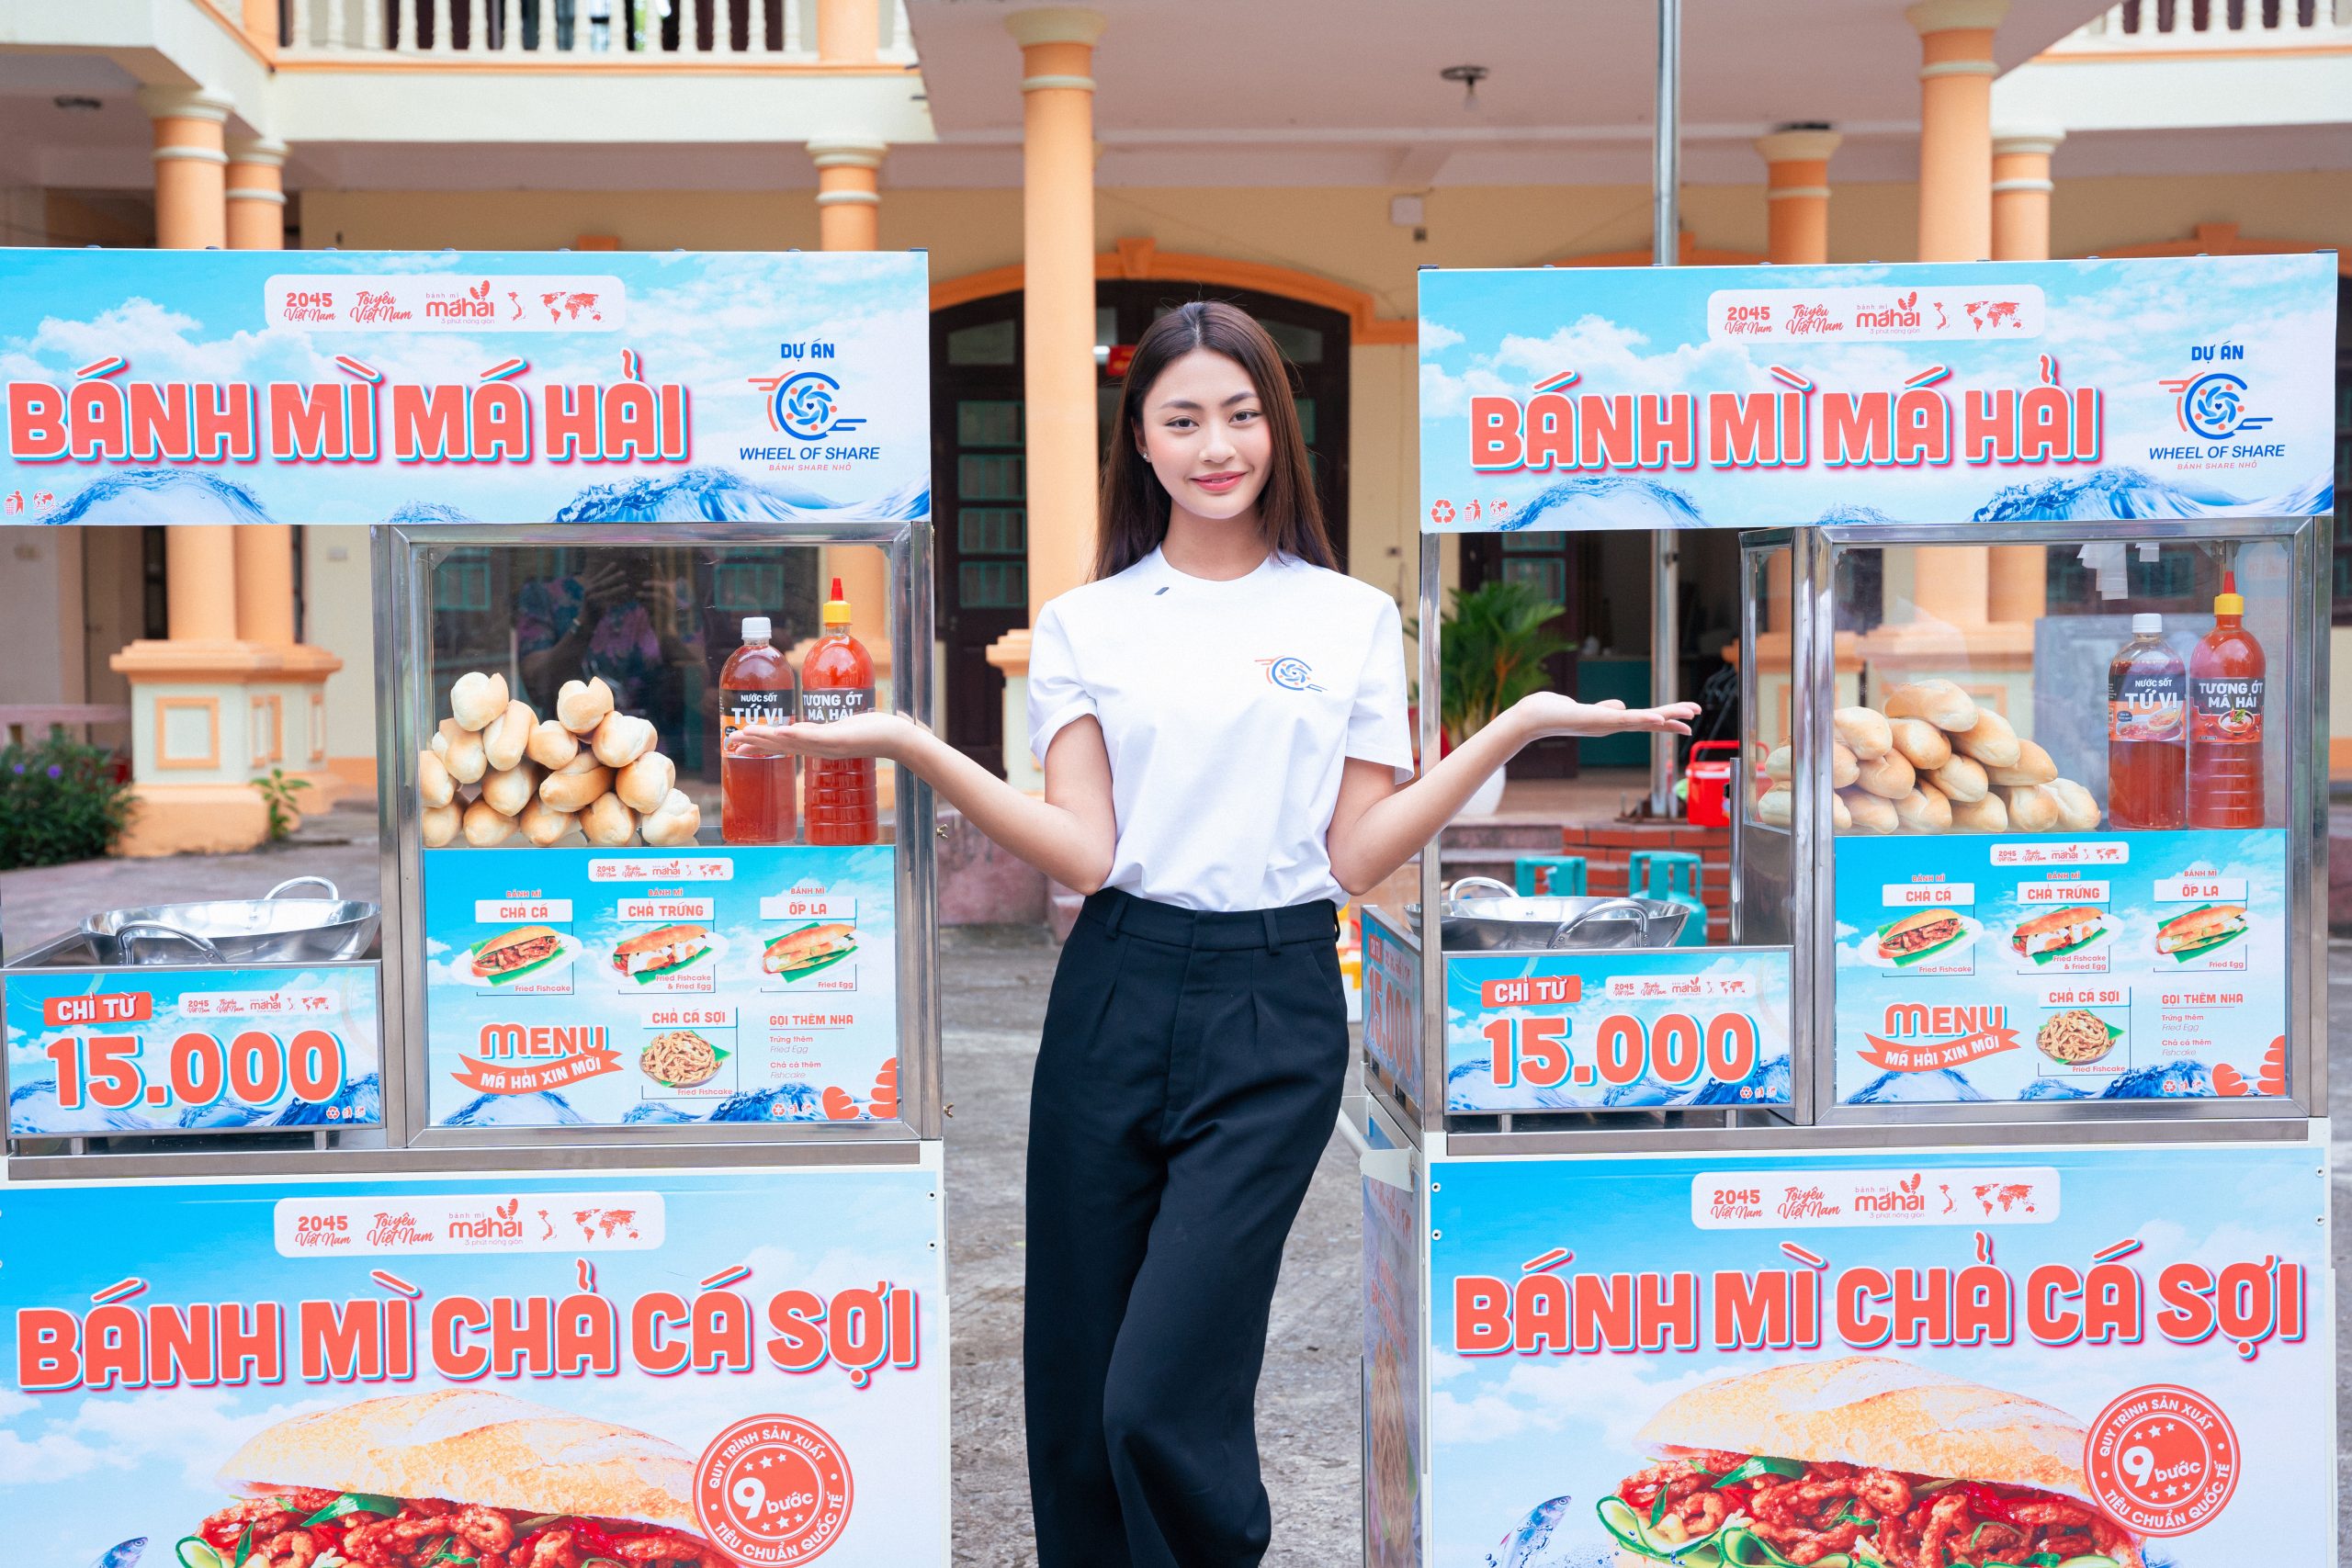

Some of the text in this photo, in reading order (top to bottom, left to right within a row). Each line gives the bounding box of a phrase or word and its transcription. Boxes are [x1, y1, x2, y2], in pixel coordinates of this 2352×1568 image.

[286, 292, 333, 308] 2045
[1727, 306, 1770, 321] 2045
[781, 338, 835, 362] DỰ ÁN
[2191, 340, 2244, 364] DỰ ÁN
[7, 348, 689, 462] BÁNH MÌ MÁ HẢI
[1470, 353, 2100, 471] BÁNH MÌ MÁ HẢI
[740, 446, 880, 459] WHEEL OF SHARE
[2149, 444, 2286, 460] WHEEL OF SHARE
[2124, 689, 2157, 710] TỨ
[730, 704, 762, 725] TỨ
[1905, 886, 1951, 902] CHẢ CÁ
[2028, 884, 2100, 899] CHẢ TRỨNG
[2203, 885, 2219, 897] LA
[500, 902, 548, 919] CHẢ CÁ
[628, 901, 704, 917] CHẢ TRỨNG
[810, 903, 827, 915] LA
[2091, 964, 2107, 972] Egg
[2229, 961, 2245, 969] Egg
[677, 974, 712, 982] Fishcake
[696, 983, 712, 991] Egg
[839, 981, 854, 989] Egg
[1494, 975, 1566, 1002] CHỈ TỪ
[57, 991, 137, 1021] CHỈ TỪ
[2049, 987, 2120, 1004] CHẢ CÁ SỢI
[2162, 991, 2244, 1007] GỌI THÊM NHA
[651, 1008, 726, 1026] CHẢ CÁ SỢI
[769, 1012, 854, 1028] GỌI THÊM NHA
[1884, 1003, 2007, 1038] MENU
[479, 1022, 609, 1059] MENU
[1483, 1011, 1760, 1089] 15.000
[1884, 1033, 2000, 1066] MÁ HẢI XIN MỜI
[47, 1028, 347, 1110] 15.000
[480, 1055, 602, 1089] MÁ HẢI XIN MỜI
[1713, 1190, 1760, 1204] 2045
[298, 1215, 348, 1231] 2045
[1453, 1247, 1698, 1355] BÁNH
[1713, 1241, 1827, 1349] MÌ
[1836, 1231, 2013, 1348] CHẢ
[2027, 1237, 2143, 1345] CÁ
[2155, 1254, 2305, 1360] SỢI
[17, 1258, 920, 1391] BÁNH MÌ CHẢ CÁ SỢI
[2099, 1395, 2213, 1457] QUY TRÌNH SẢN XUẤT
[708, 1426, 827, 1489] QUY TRÌNH SẢN XUẤT
[2121, 1445, 2201, 1488] 9 bước
[732, 1477, 814, 1520] 9 bước
[2104, 1460, 2231, 1529] TIÊU CHUẨN QUỐC TẾ
[714, 1491, 843, 1561] TIÊU CHUẨN QUỐC TẾ
